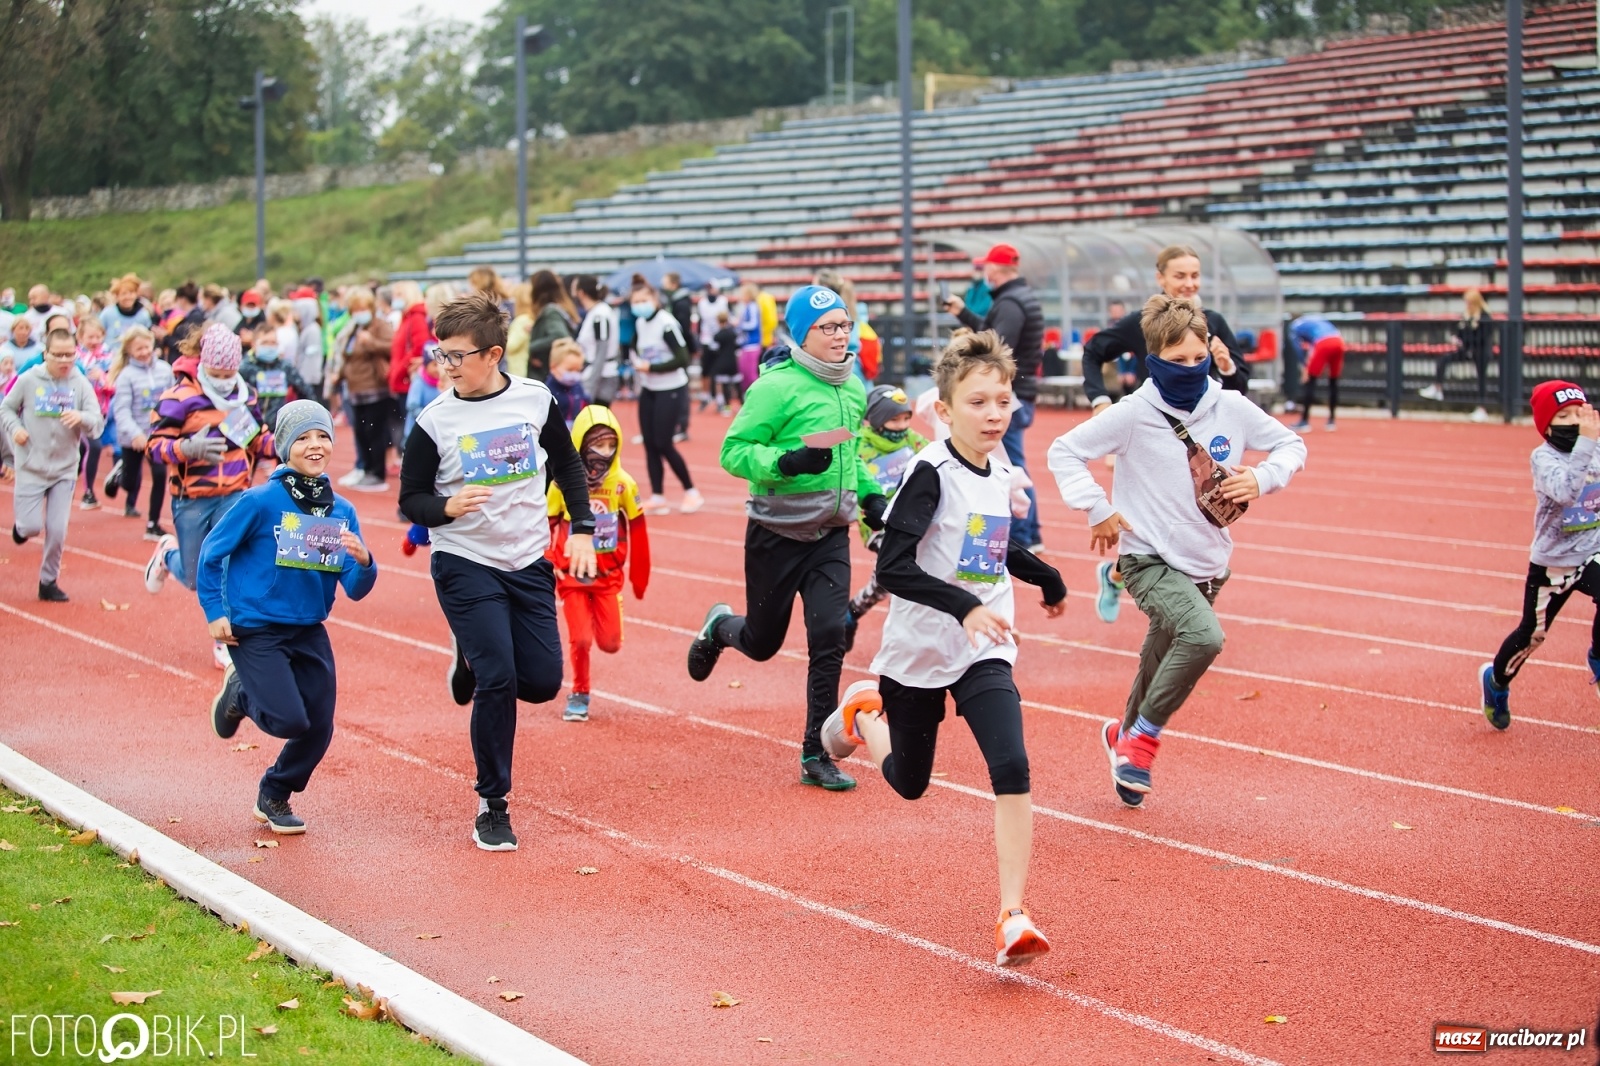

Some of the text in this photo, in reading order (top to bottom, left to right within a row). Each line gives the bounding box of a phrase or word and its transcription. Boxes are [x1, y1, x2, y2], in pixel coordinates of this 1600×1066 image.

[488, 448, 502, 456] DLA
[1211, 444, 1230, 453] NASA
[507, 458, 531, 475] 286
[290, 531, 303, 540] BIEG
[306, 534, 319, 542] DLA
[320, 553, 339, 566] 181
